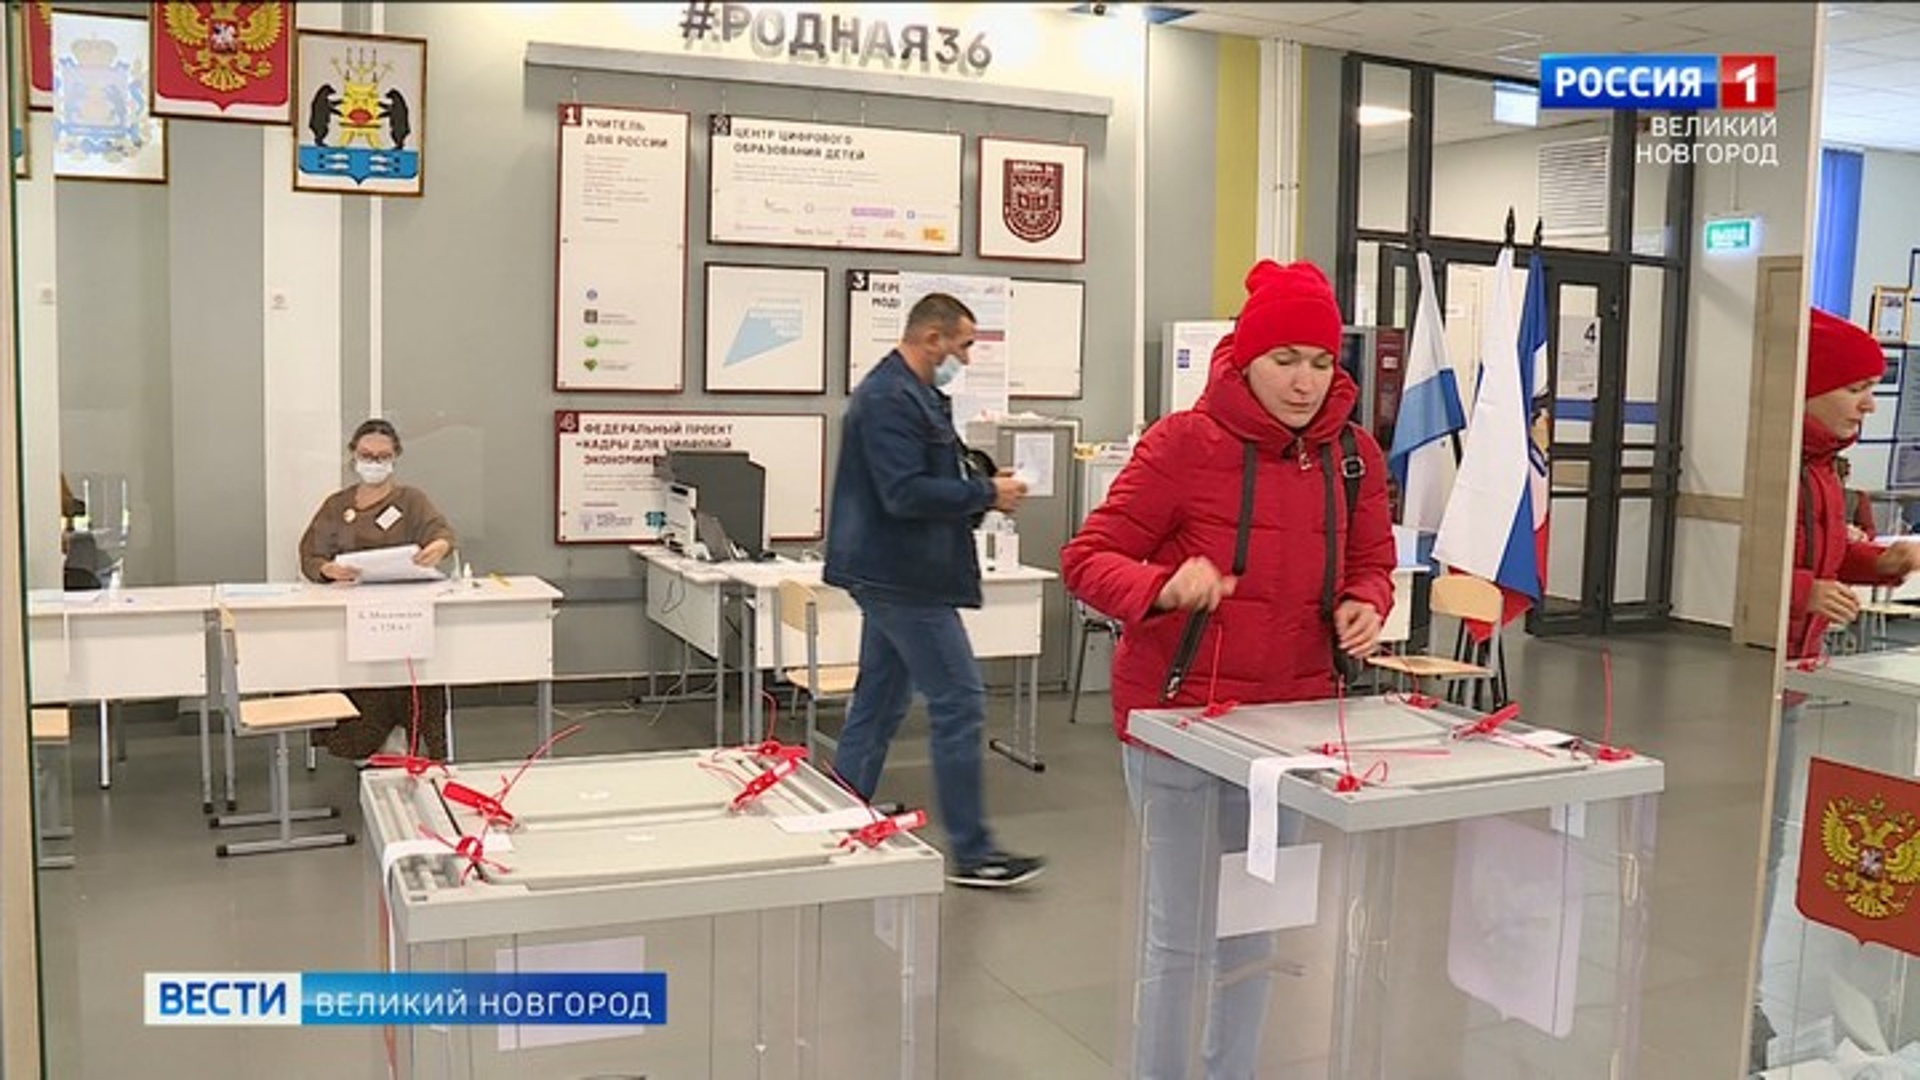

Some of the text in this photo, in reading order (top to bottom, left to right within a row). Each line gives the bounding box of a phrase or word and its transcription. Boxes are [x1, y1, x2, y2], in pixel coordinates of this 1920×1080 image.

[679, 3, 992, 69] #РОДНАЯ36
[565, 106, 577, 124] 1
[586, 118, 645, 131] УЧИТЕЛЬ
[584, 133, 668, 148] ДЛЯ РОССИИ
[734, 128, 853, 144] ЦЕНТР ЦИФРОВОГО
[733, 142, 866, 161] ОБРАЗОВАНИЯ ДЕТЕЙ
[852, 271, 866, 290] 3
[1584, 322, 1597, 345] 4
[584, 421, 733, 436] ФЕДЕРАЛЬНЫЙ ПРОЕКТ
[632, 438, 660, 451] ДЛЯ
